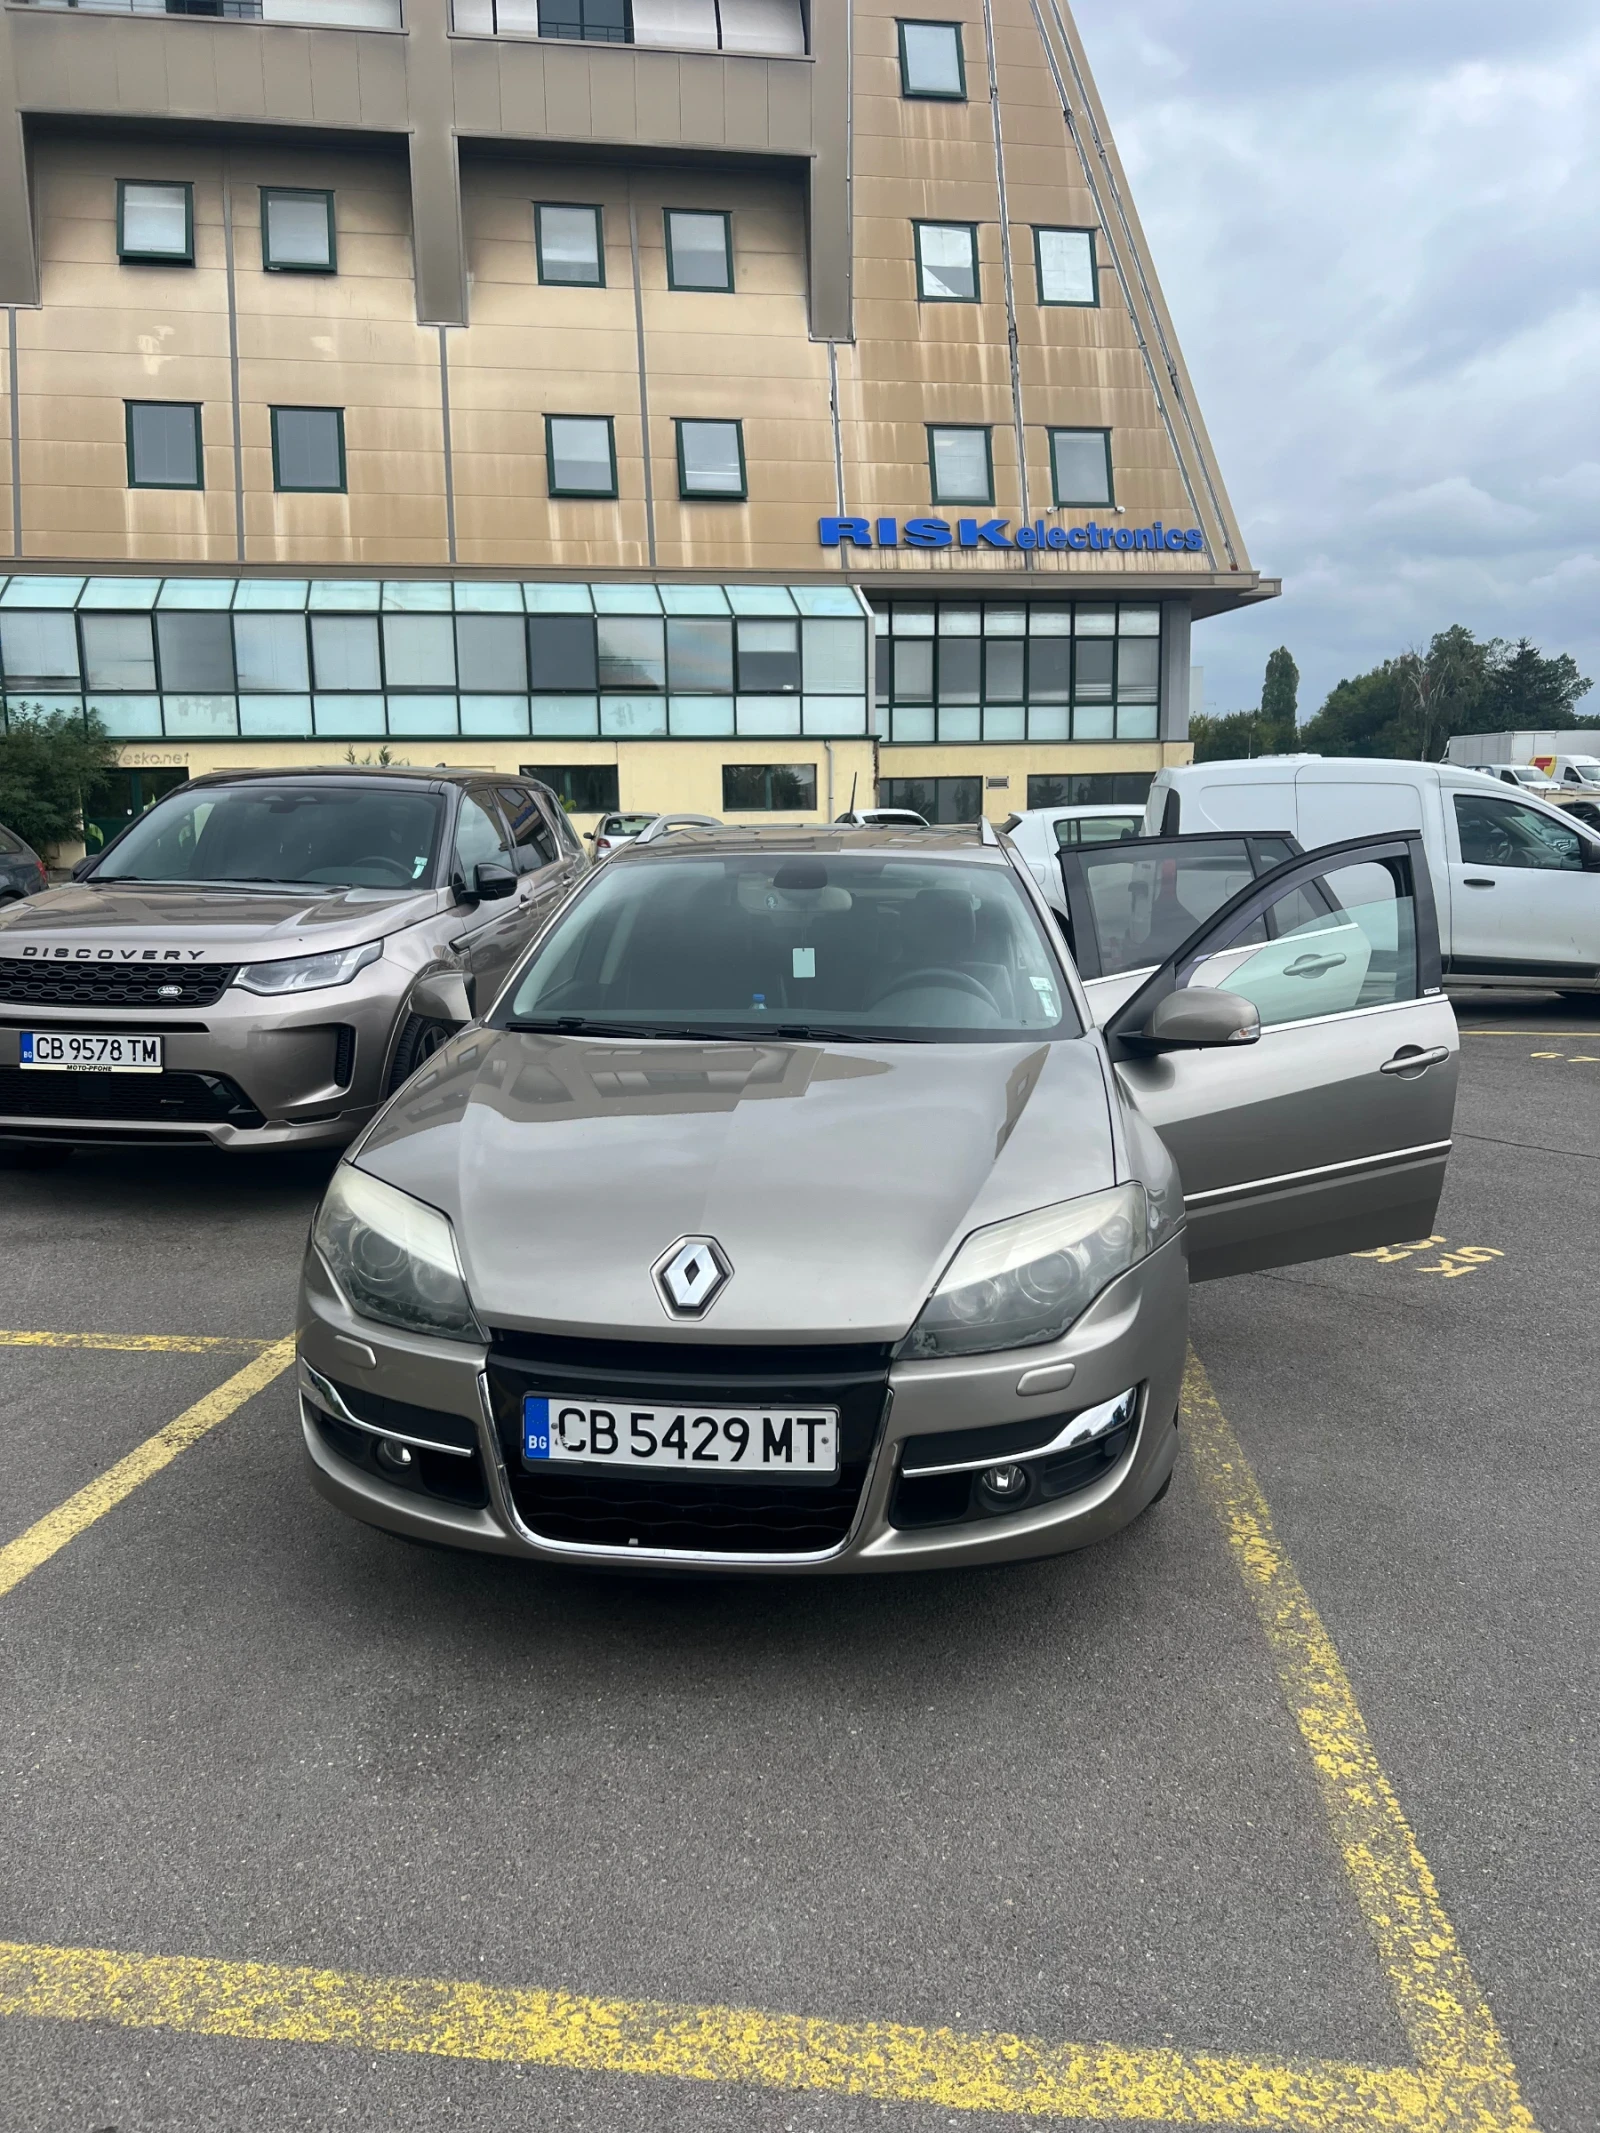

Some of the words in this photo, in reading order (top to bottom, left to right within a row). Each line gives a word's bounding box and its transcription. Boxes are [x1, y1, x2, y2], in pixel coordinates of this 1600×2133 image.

[819, 516, 1015, 547] RISK
[1015, 519, 1204, 551] electronics
[22, 946, 206, 961] DISCOVERY
[23, 1051, 33, 1059] BG
[36, 1037, 64, 1060] CB
[68, 1038, 123, 1061] 9578
[127, 1039, 157, 1063] TM
[528, 1436, 547, 1449] BG
[558, 1407, 619, 1454] CB
[630, 1412, 750, 1462] 5429
[762, 1417, 827, 1463] MT
